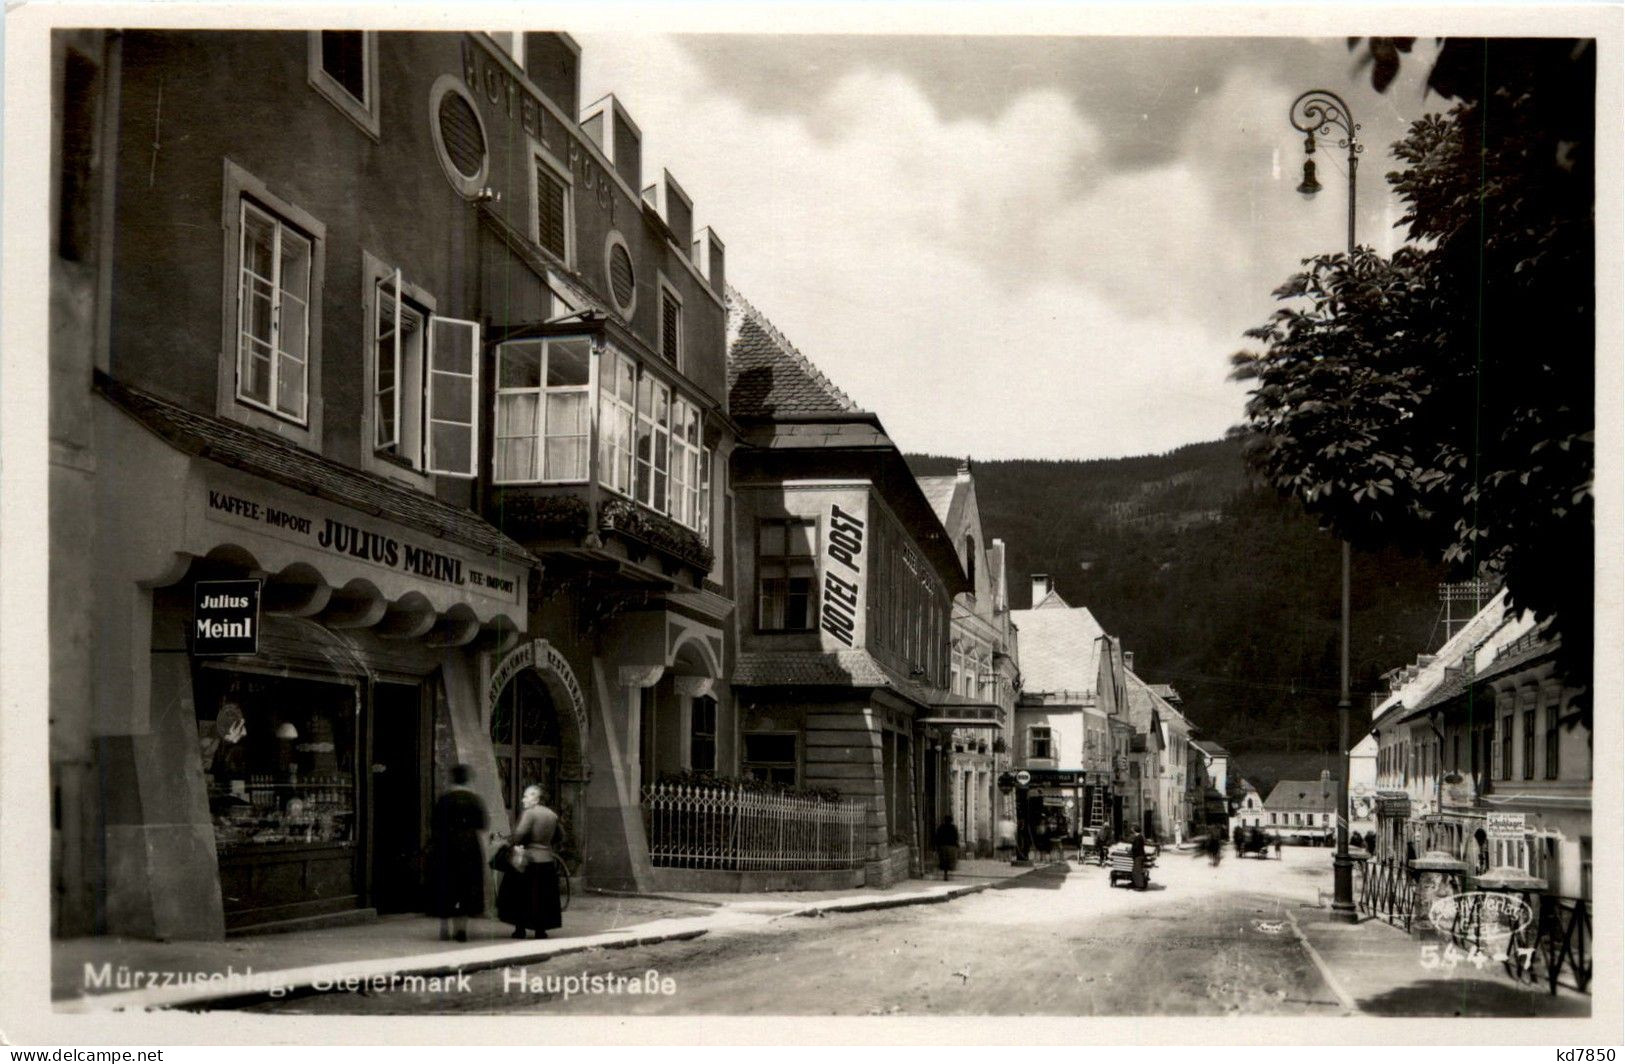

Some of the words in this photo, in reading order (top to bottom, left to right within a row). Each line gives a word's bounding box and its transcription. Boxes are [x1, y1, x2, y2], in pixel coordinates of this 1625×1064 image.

[461, 38, 549, 150] HOTEL
[567, 131, 617, 226] POST
[318, 518, 398, 567] JULIUS
[404, 544, 465, 586] MEINL
[828, 503, 865, 573] POST
[196, 617, 252, 639] Meinl
[200, 594, 249, 609] Julius
[821, 570, 859, 648] HOTEL
